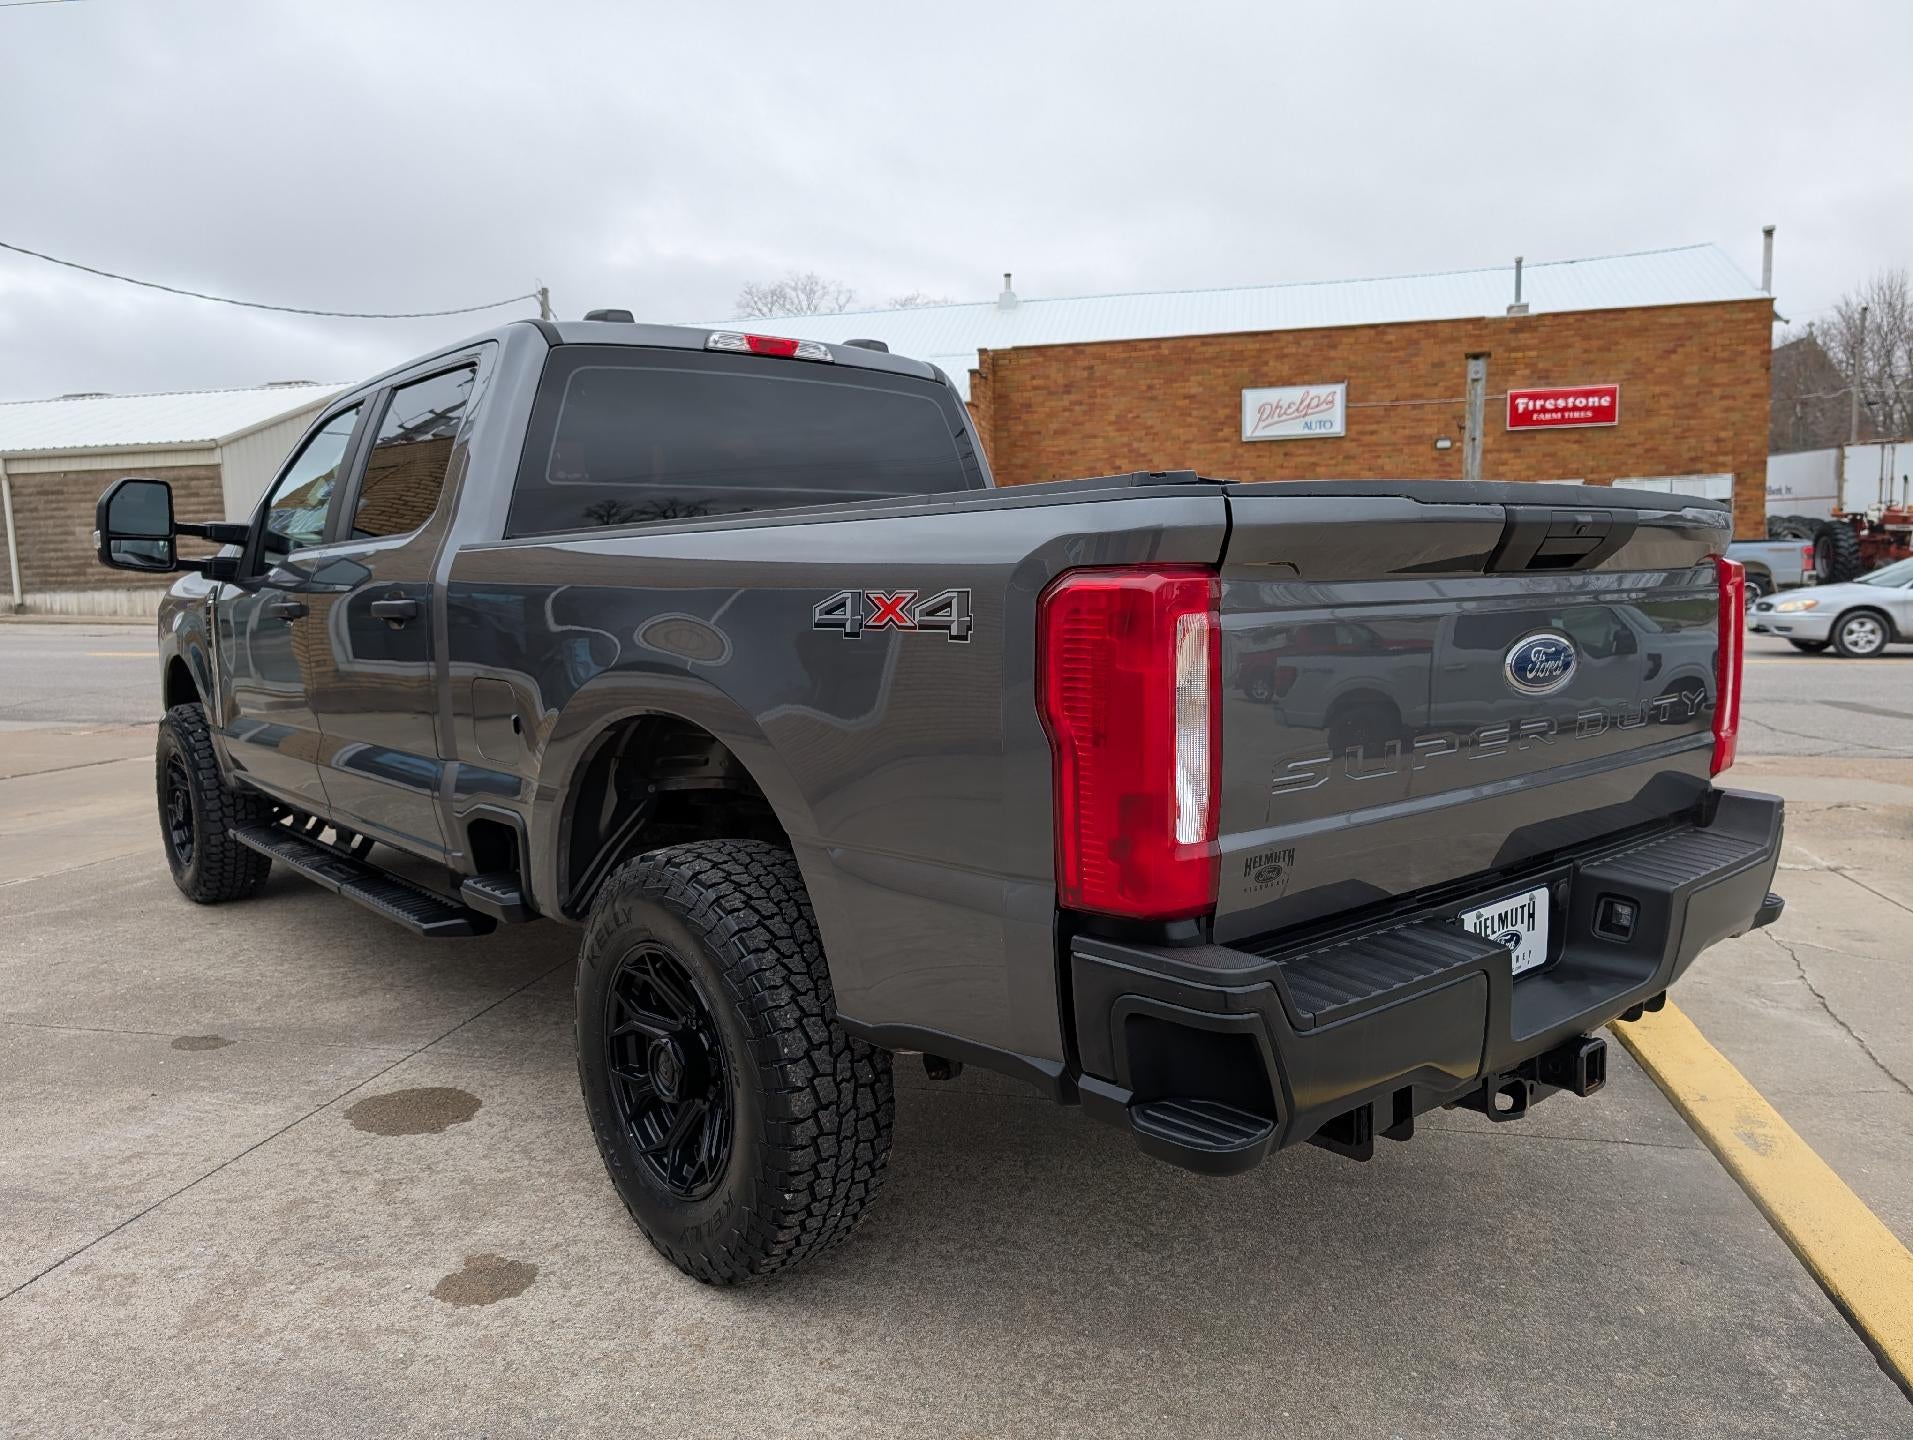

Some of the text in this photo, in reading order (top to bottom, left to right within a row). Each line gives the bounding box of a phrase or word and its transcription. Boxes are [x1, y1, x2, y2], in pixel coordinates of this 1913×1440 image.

[1251, 390, 1337, 435] Phelps
[1514, 395, 1612, 414] Firestone
[1532, 410, 1593, 421] FARM TIRES
[1302, 420, 1334, 431] AUTO
[1526, 647, 1565, 679] Ford
[1271, 687, 1706, 795] SUPER DUTY
[1243, 847, 1296, 878] HELMUTH
